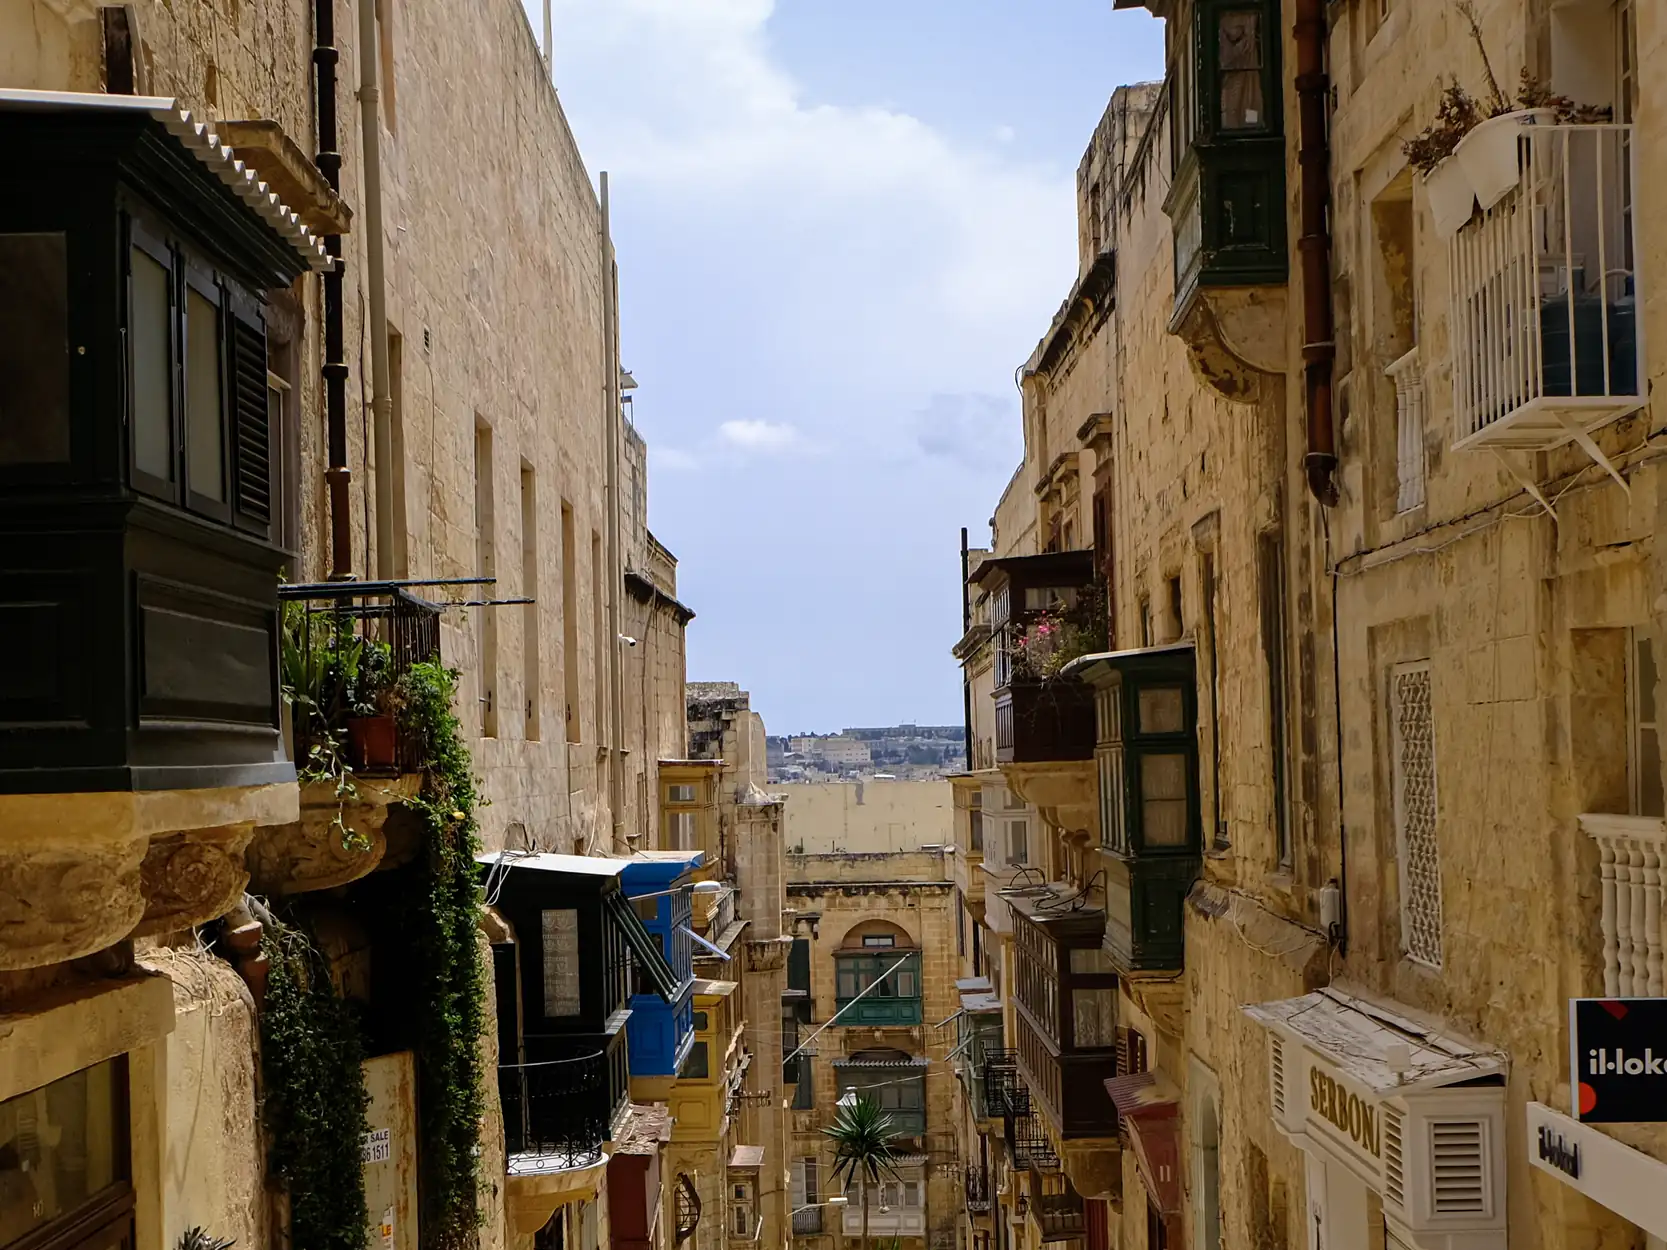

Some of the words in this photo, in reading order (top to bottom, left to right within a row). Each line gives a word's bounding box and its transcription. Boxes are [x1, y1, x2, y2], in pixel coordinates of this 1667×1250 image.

[1589, 1048, 1667, 1075] il·lok
[370, 1130, 389, 1143] SALE
[372, 1142, 389, 1160] 1511
